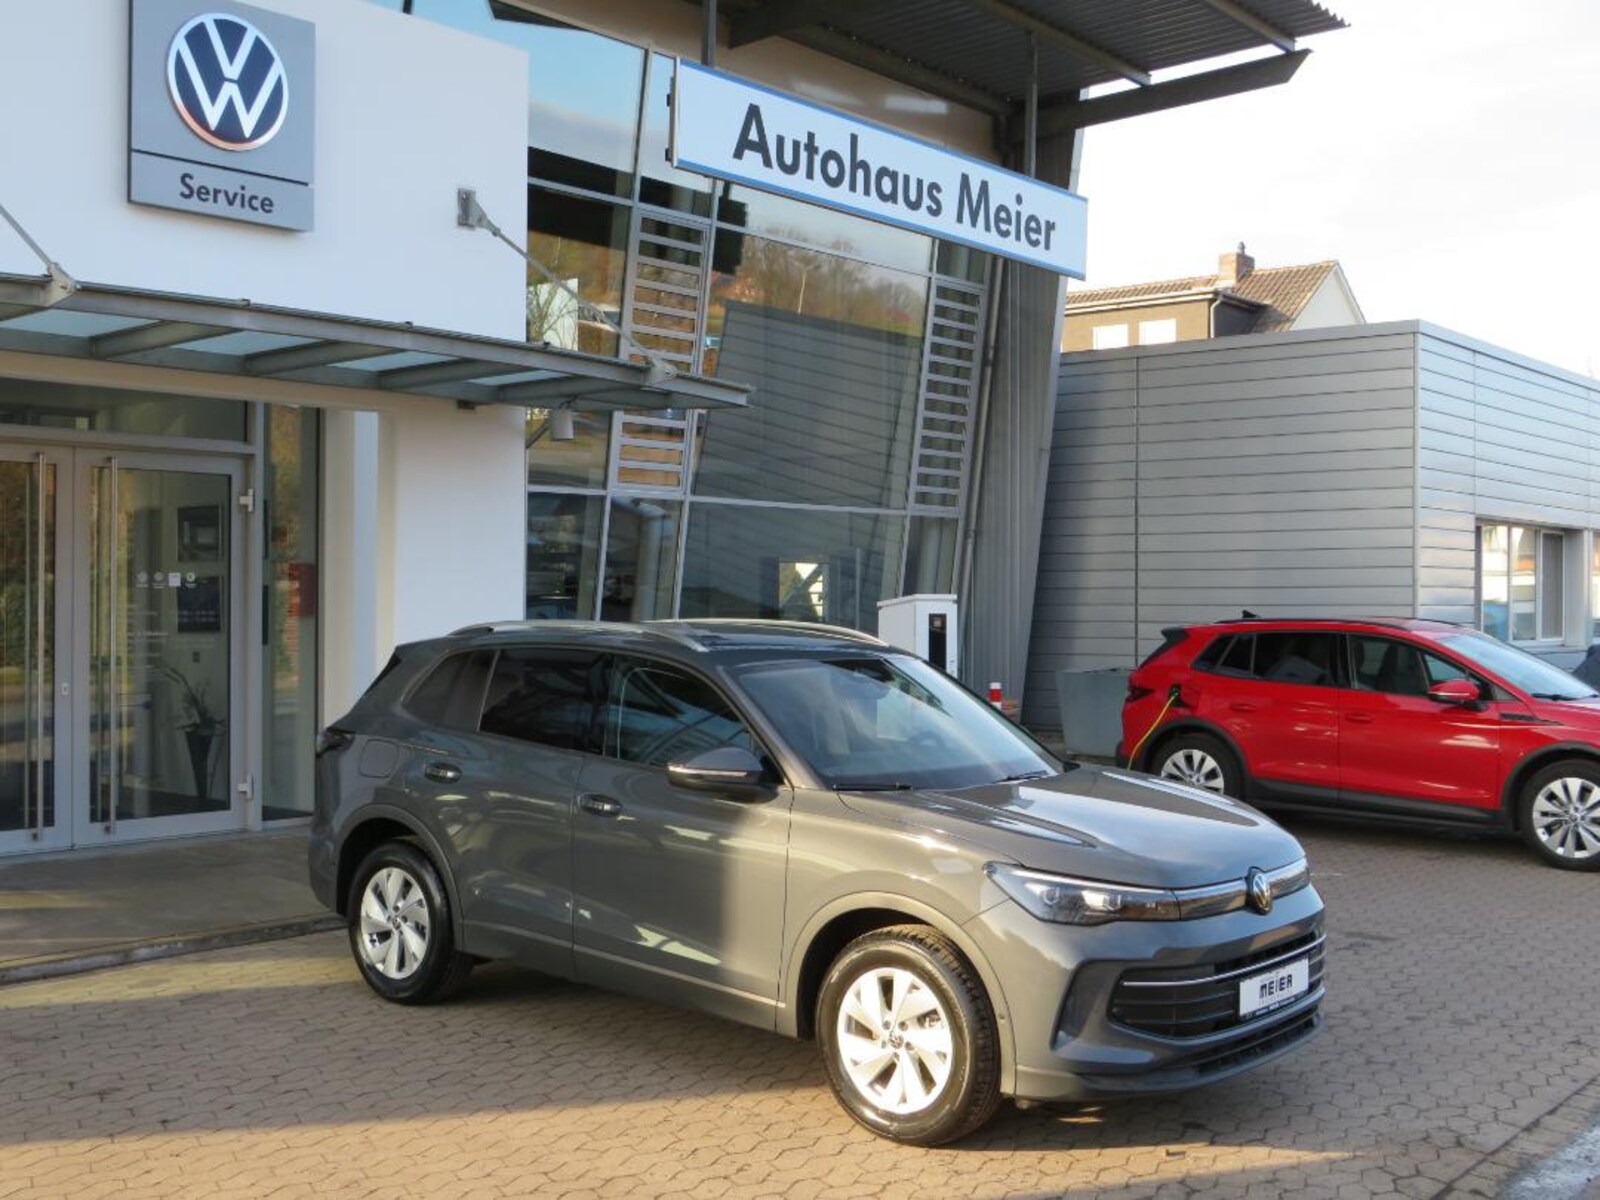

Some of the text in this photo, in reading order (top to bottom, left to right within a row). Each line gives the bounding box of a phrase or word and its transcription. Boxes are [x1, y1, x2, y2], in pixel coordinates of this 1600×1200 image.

[171, 14, 286, 143] VW
[179, 172, 275, 214] Service
[733, 102, 1056, 251] Autohaus Meier
